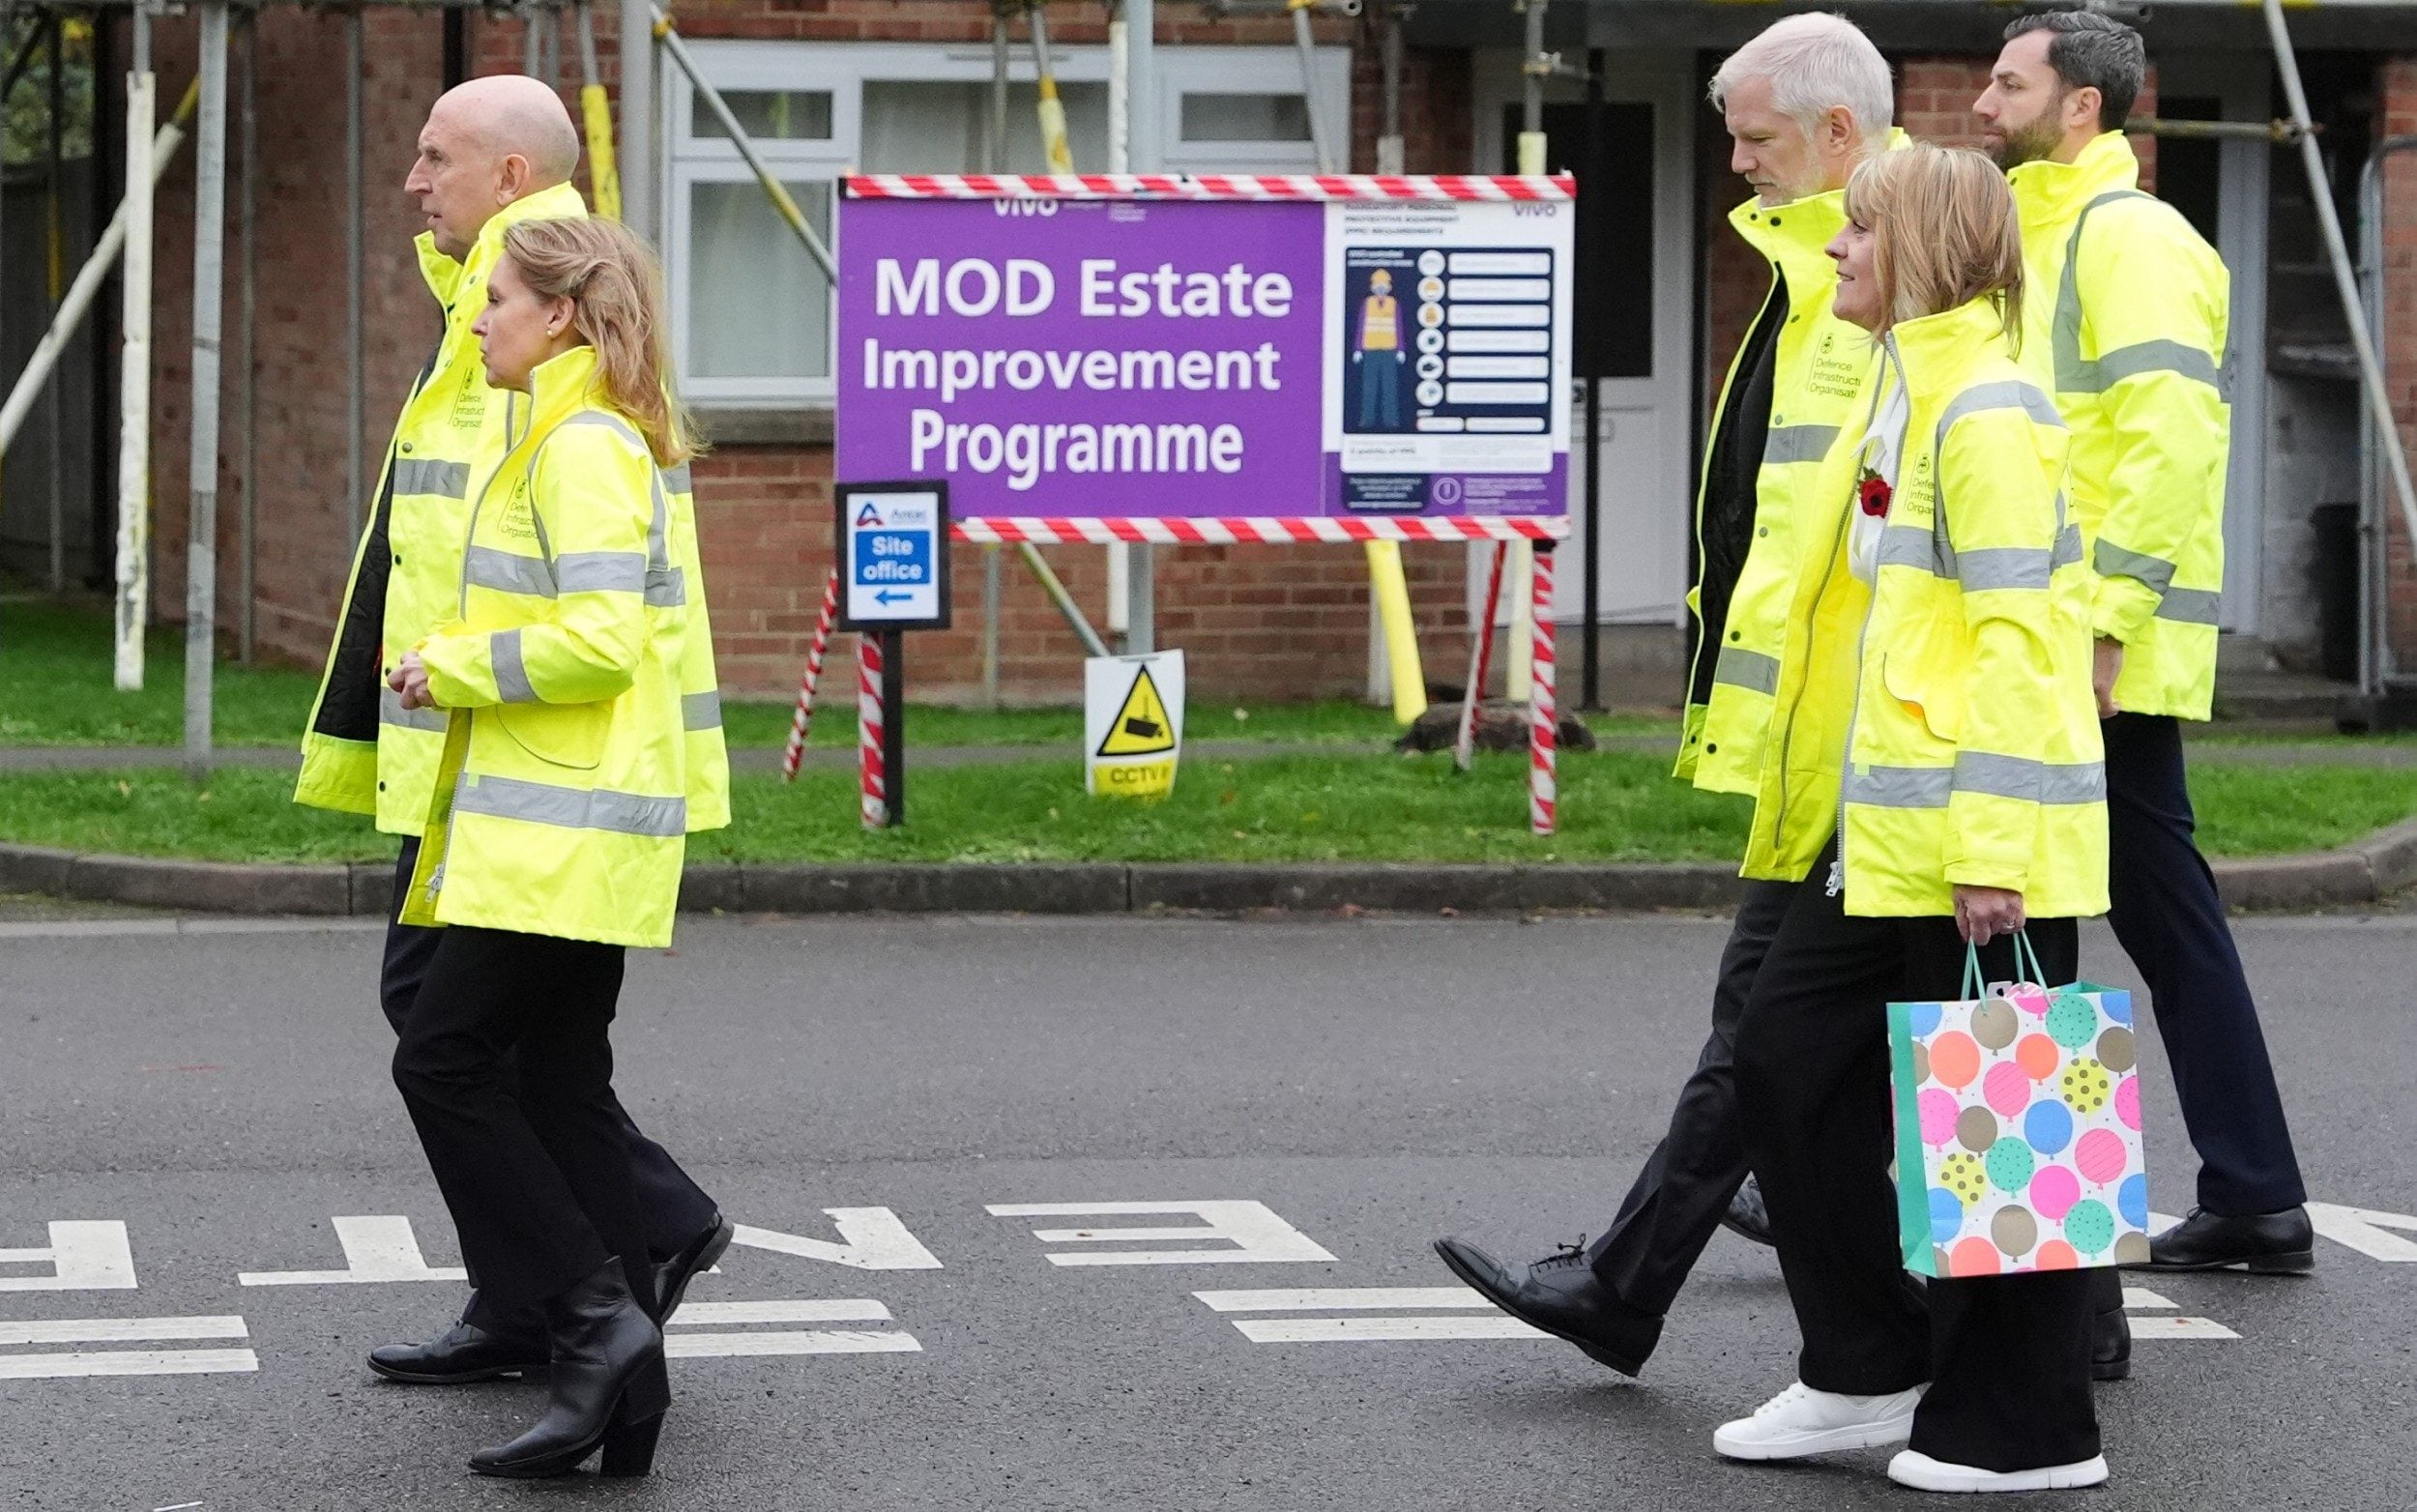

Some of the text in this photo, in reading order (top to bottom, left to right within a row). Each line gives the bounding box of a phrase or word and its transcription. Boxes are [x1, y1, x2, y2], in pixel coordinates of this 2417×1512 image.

[876, 258, 1293, 317] MOD Estate
[864, 337, 1281, 401] Improvement
[1816, 357, 1852, 372] Defence
[912, 409, 1244, 489] Programme
[872, 536, 914, 556] Site
[863, 560, 922, 580] office
[1111, 766, 1163, 784] CCTV
